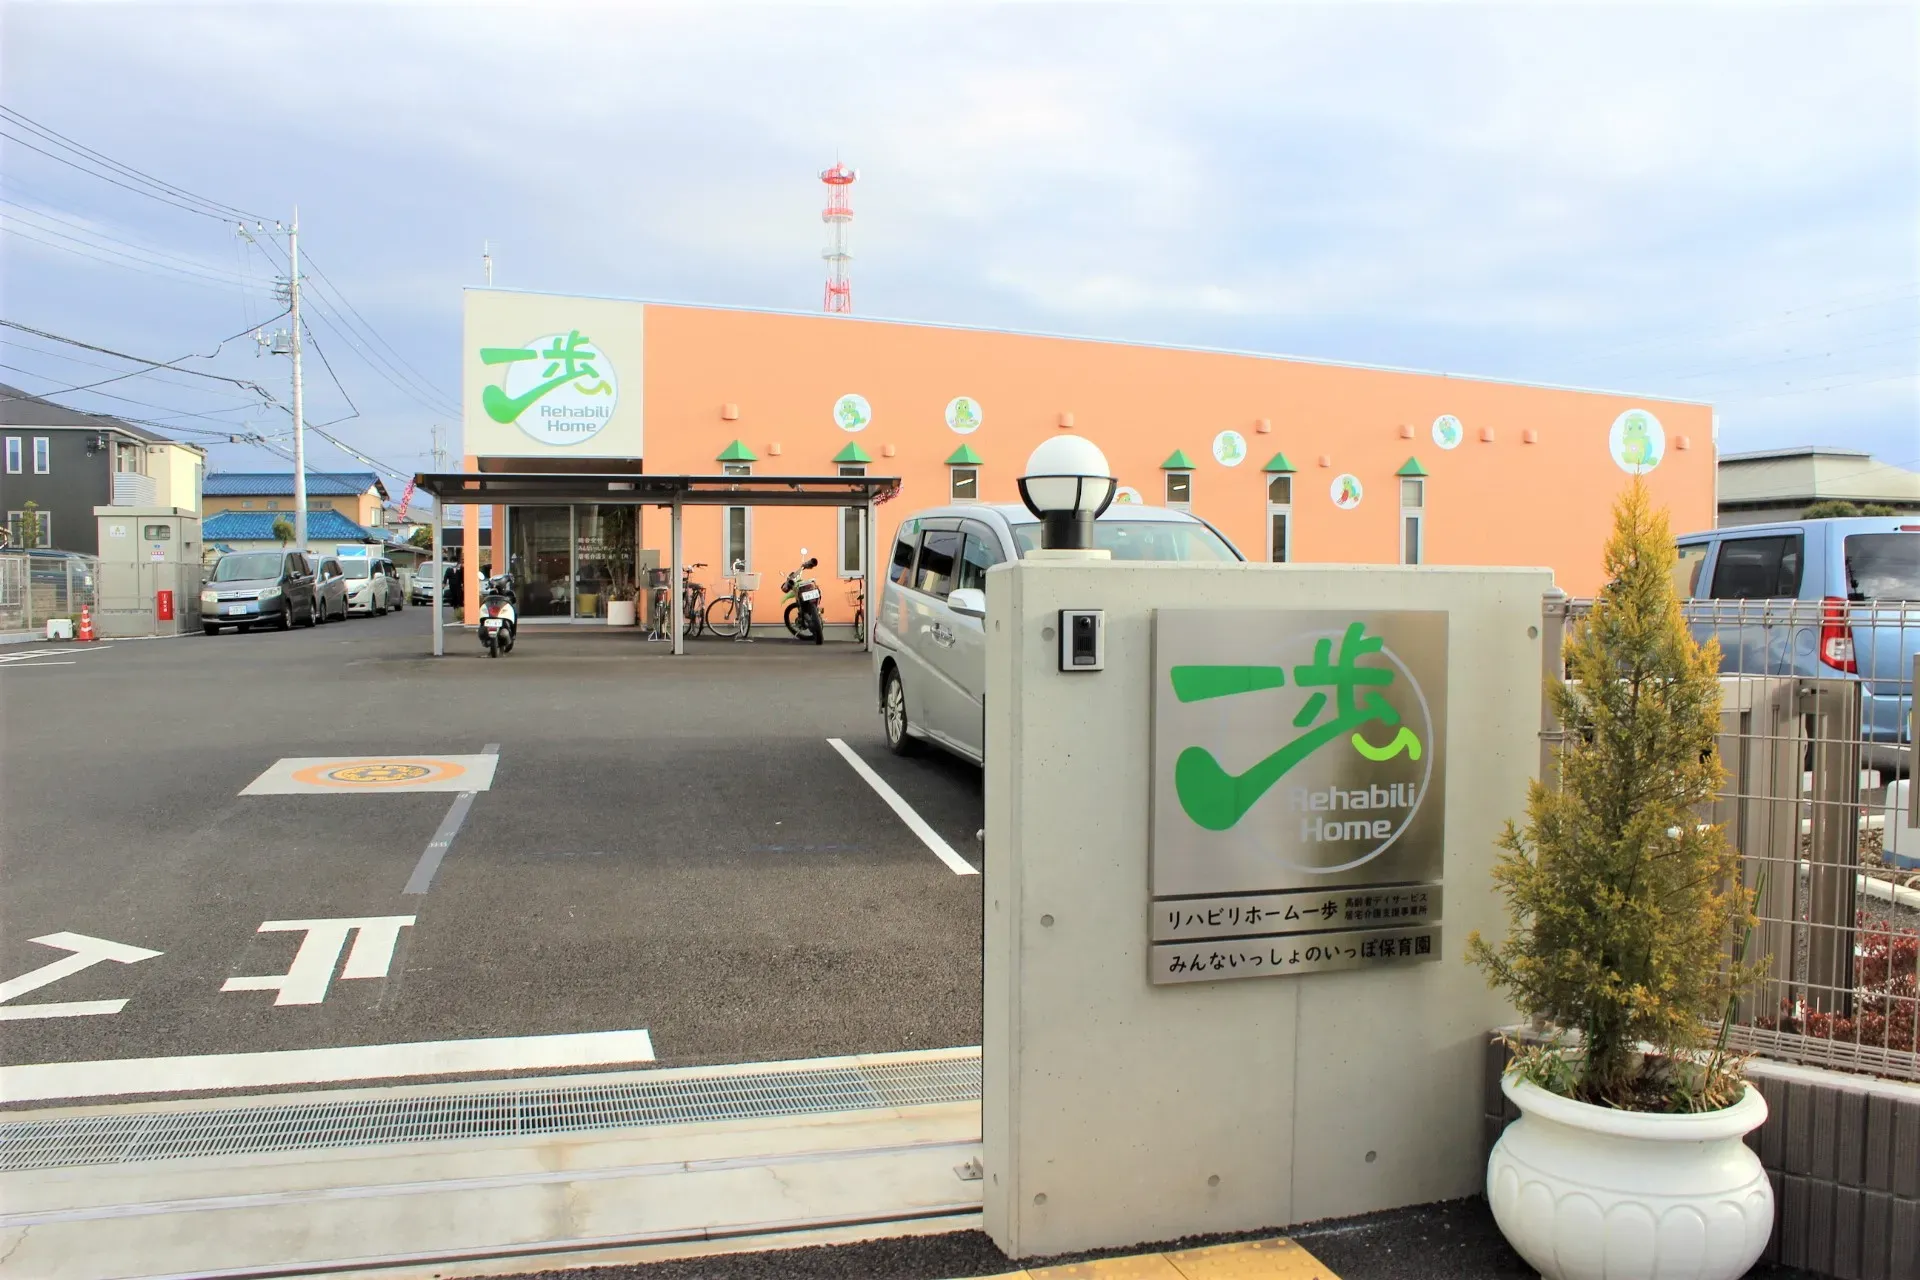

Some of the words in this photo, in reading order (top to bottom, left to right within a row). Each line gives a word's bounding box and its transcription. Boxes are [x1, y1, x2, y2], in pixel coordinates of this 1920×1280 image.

[480, 329, 612, 424] 一歩
[540, 405, 610, 418] Rehabili
[547, 420, 597, 432] Home
[1170, 622, 1421, 831] 一歩
[1291, 783, 1416, 813] Rehabili
[1301, 817, 1392, 844] Home
[1345, 892, 1428, 908] 高齢者デイサービス
[1345, 905, 1428, 920] 居宅介護支援事業所
[1168, 900, 1339, 930] リハビリホーム一歩
[1168, 935, 1431, 974] みんないっしょのいっぽ保育園
